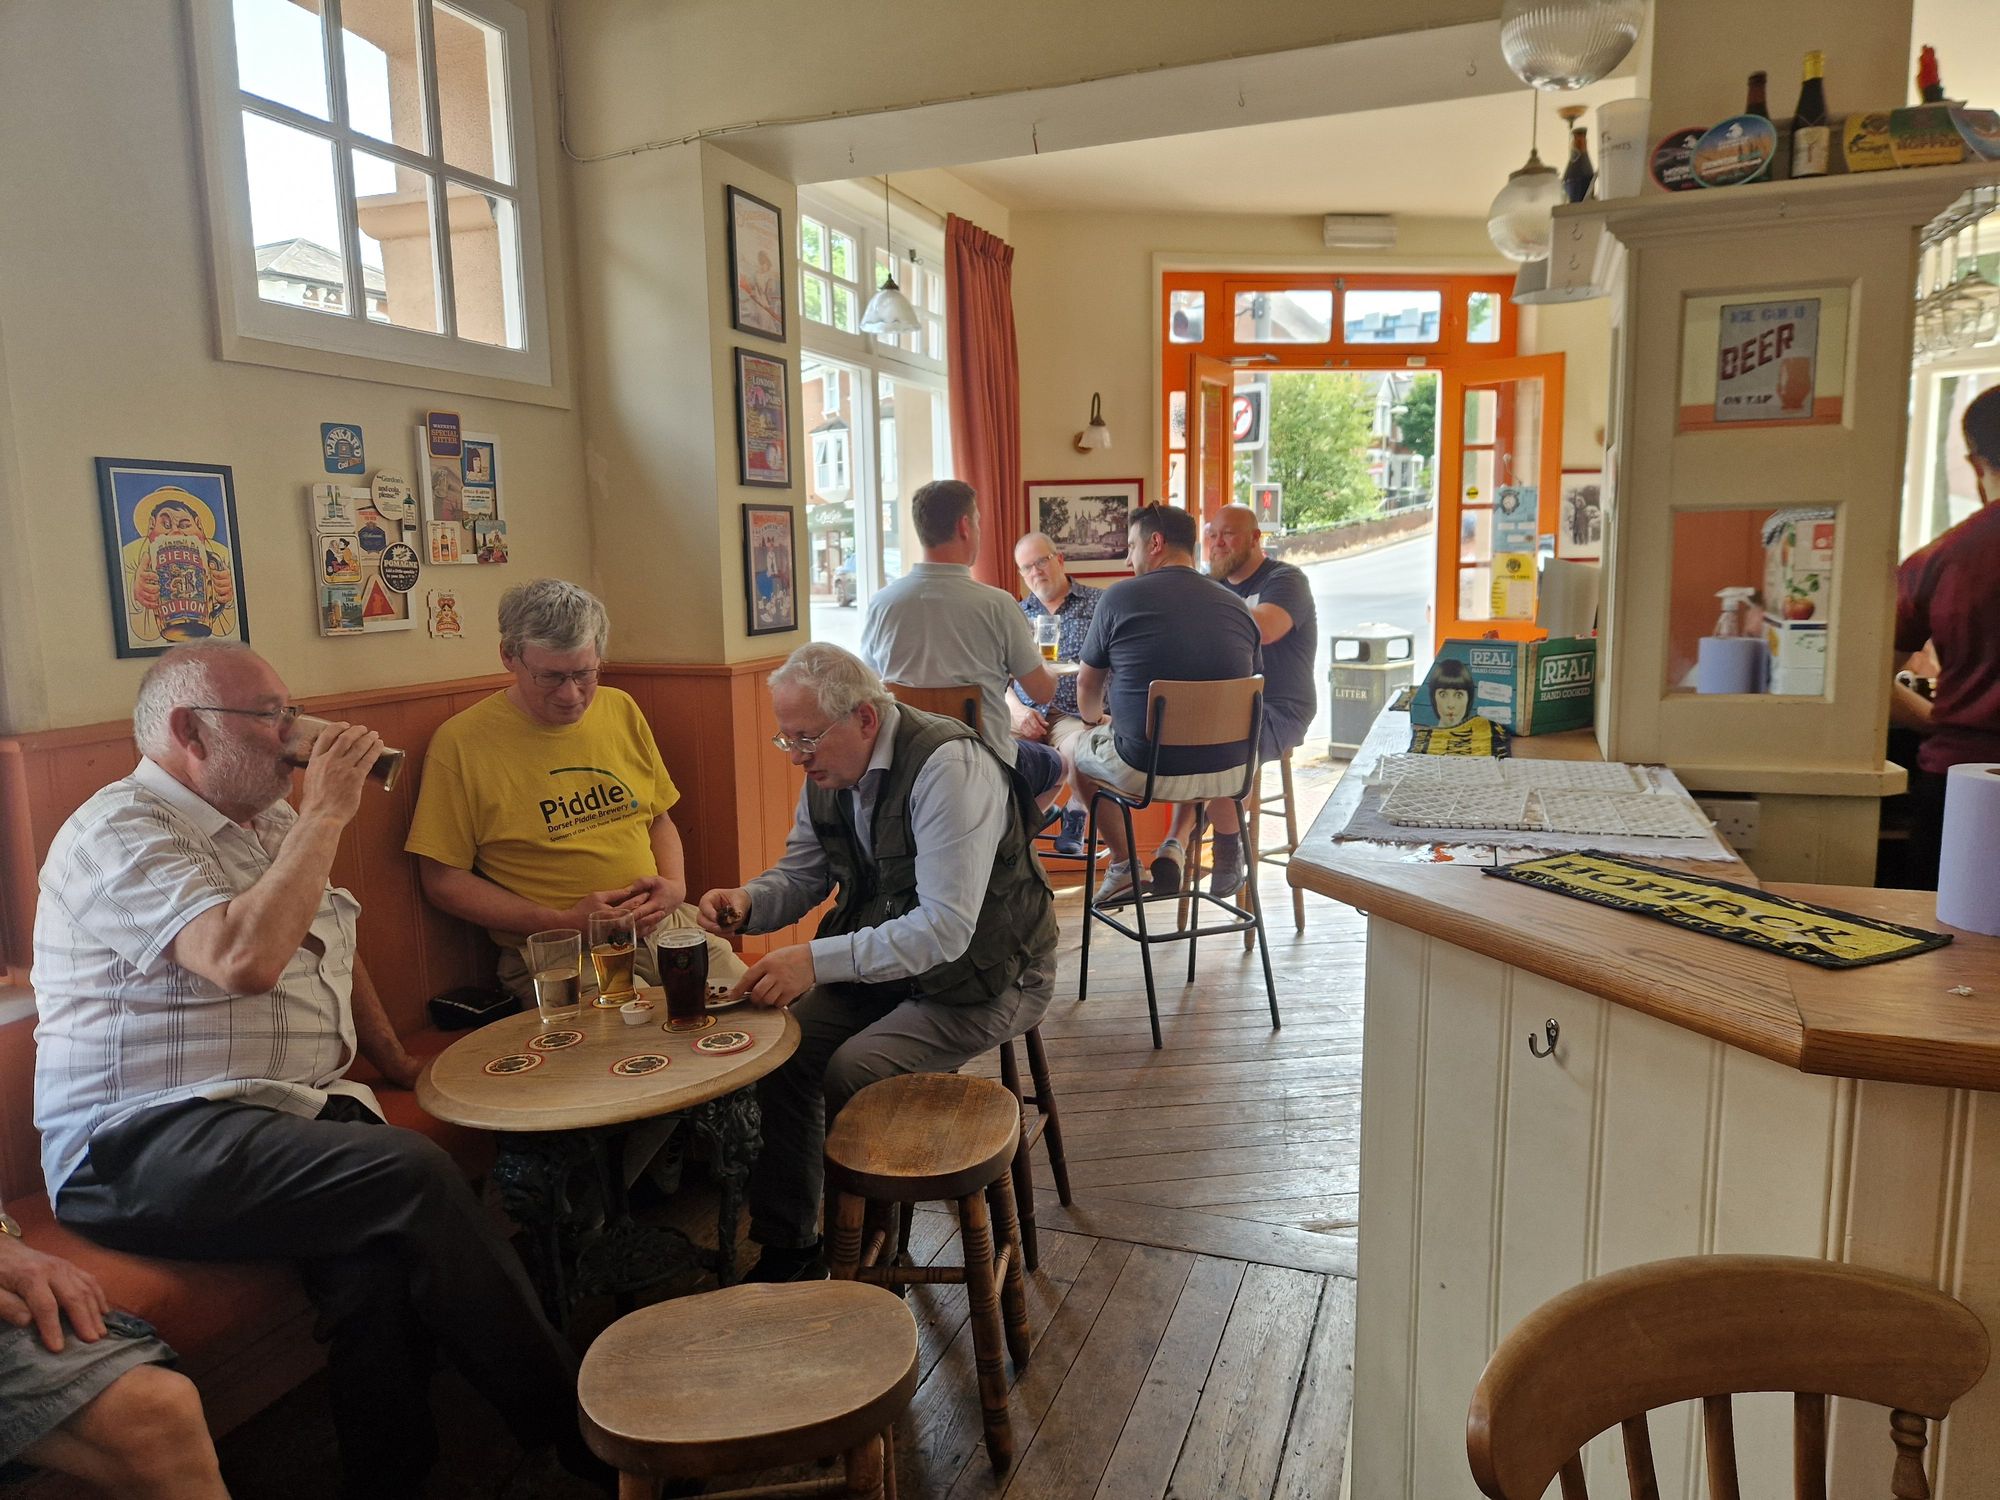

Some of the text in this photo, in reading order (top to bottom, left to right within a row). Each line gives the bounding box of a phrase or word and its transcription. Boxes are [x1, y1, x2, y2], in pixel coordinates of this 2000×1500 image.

[1720, 323, 1795, 381] BEER
[431, 429, 458, 438] SPECIAL
[432, 436, 457, 444] BITTER
[326, 428, 361, 457] TANKARD
[158, 550, 200, 565] BIERE
[383, 559, 419, 569] POMAGNE
[161, 600, 205, 616] DU LION
[1472, 651, 1511, 666] REAL
[1543, 657, 1591, 685] REAL
[1335, 688, 1368, 699] LITTER
[1541, 687, 1591, 701] HAND COOKED
[539, 784, 624, 824] Piddle
[547, 803, 629, 833] Dorset Piddle Brewery
